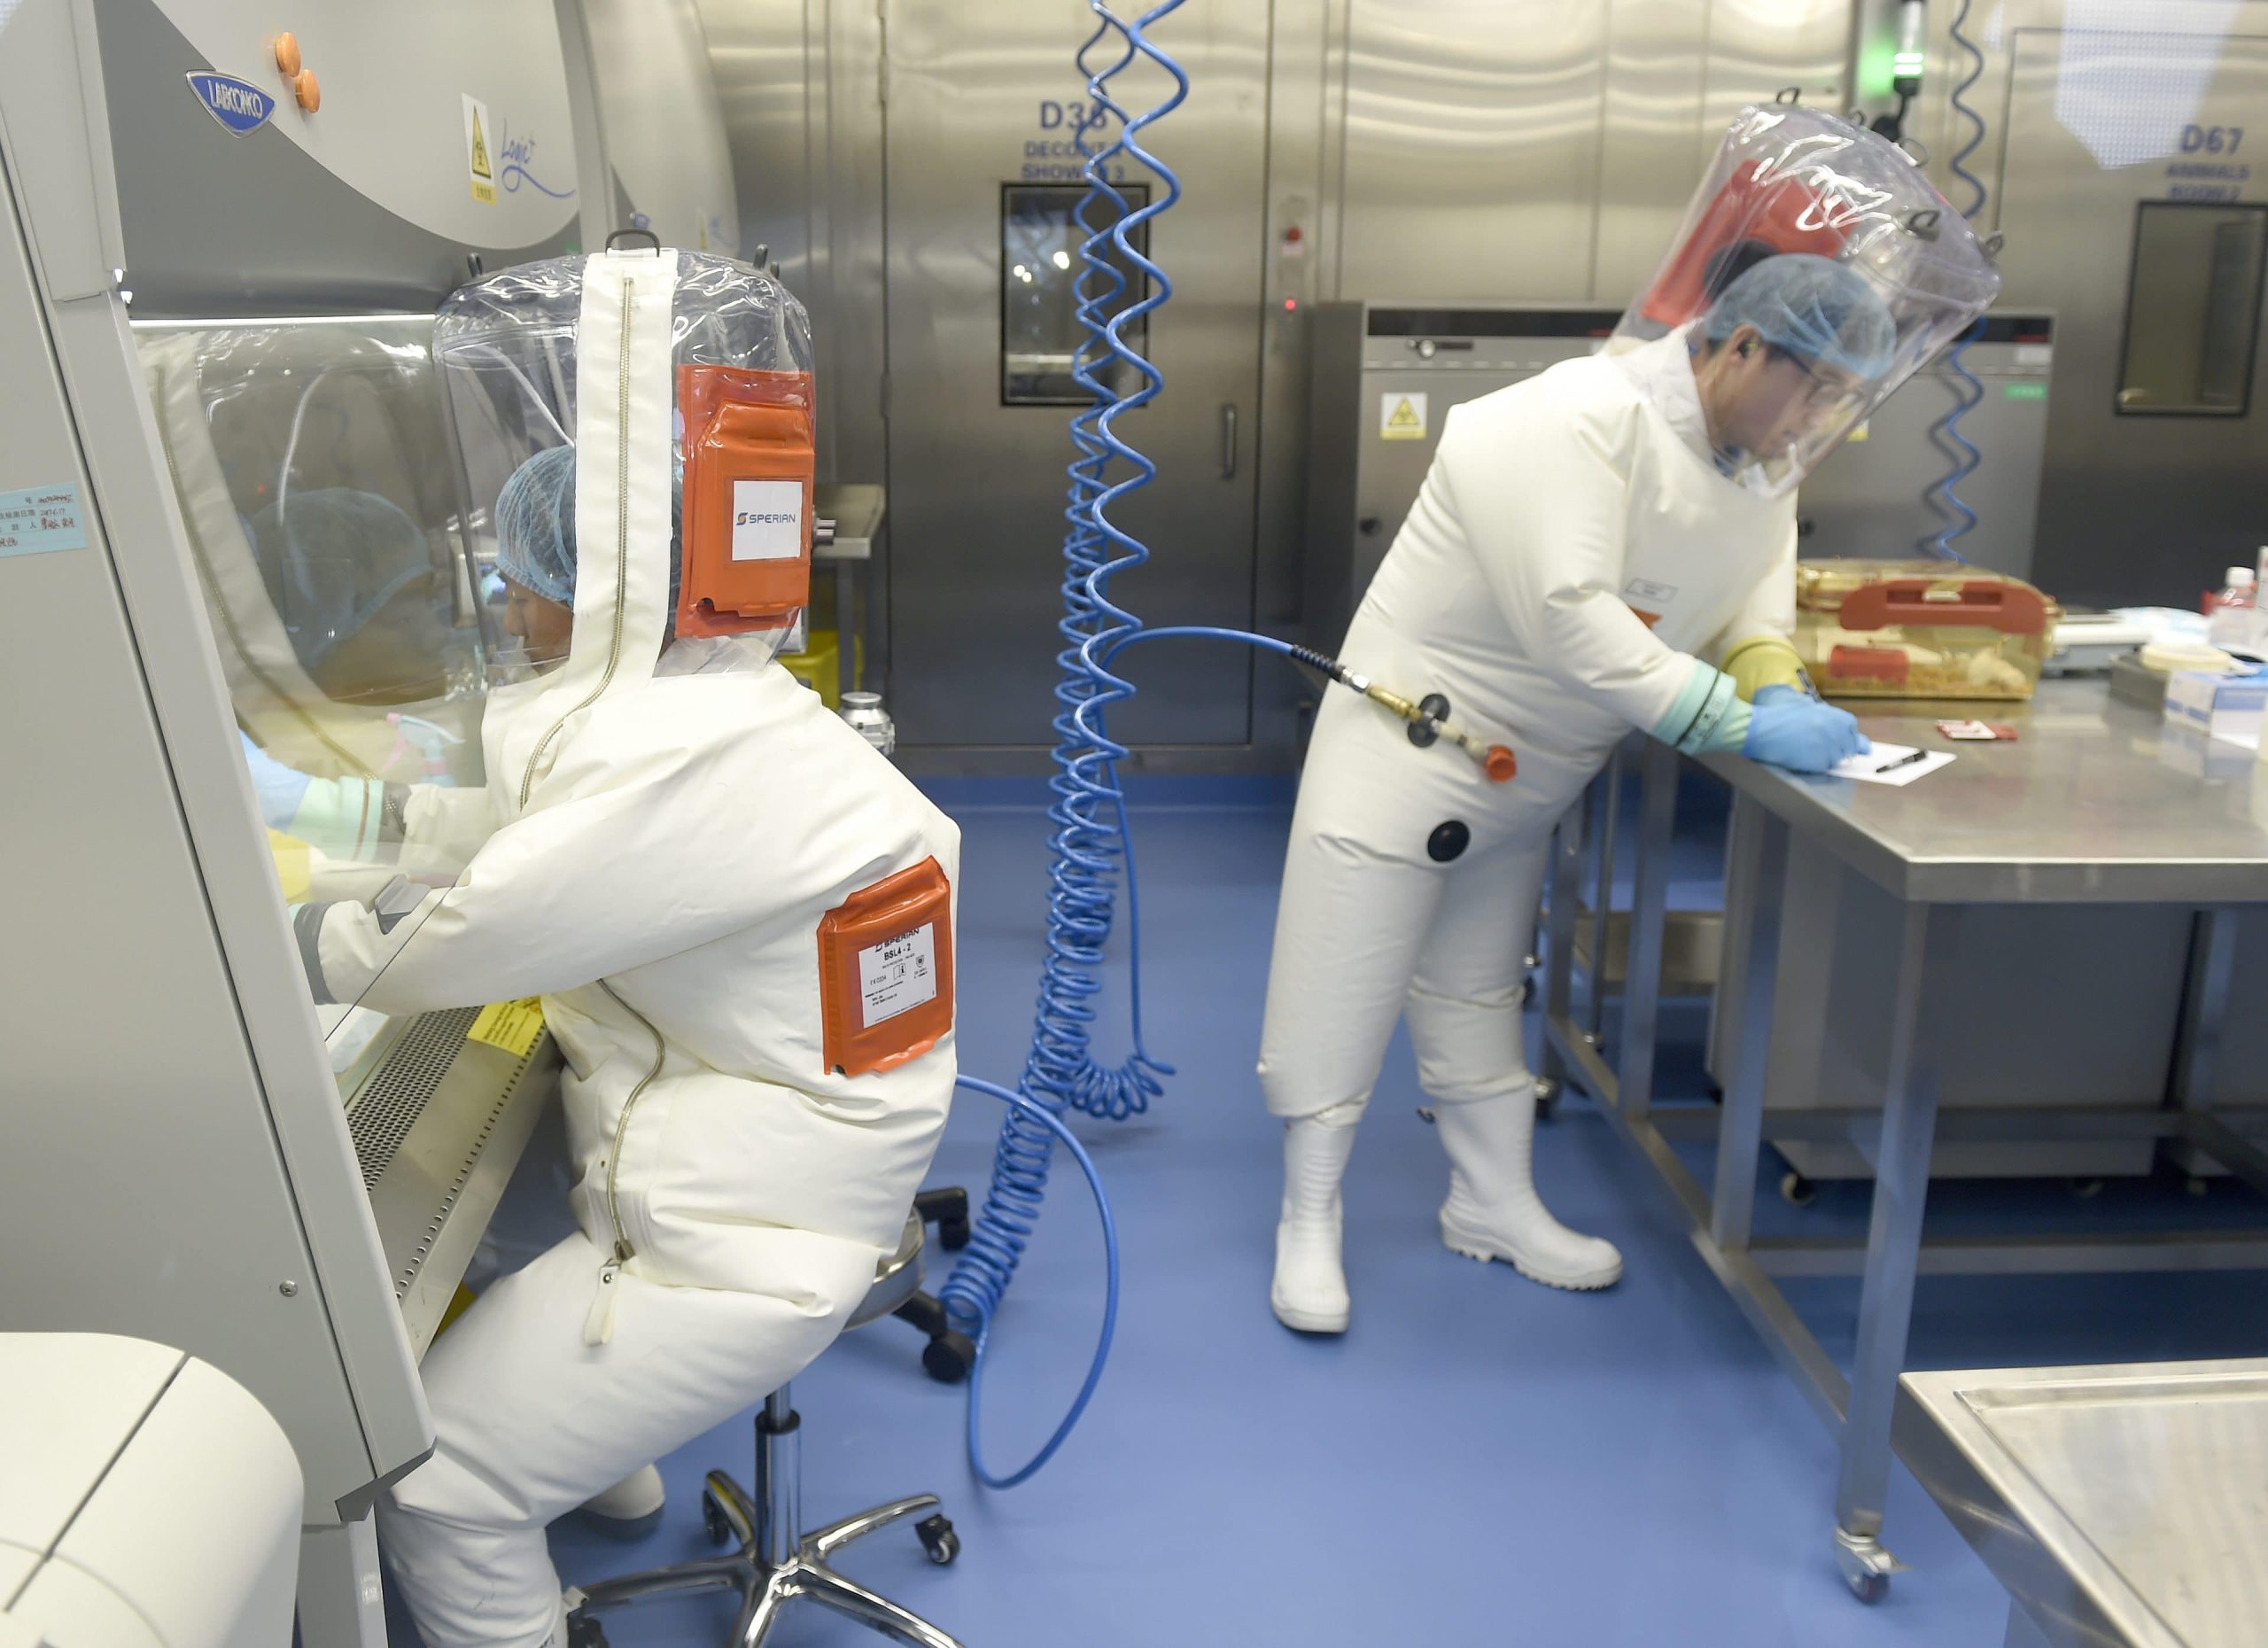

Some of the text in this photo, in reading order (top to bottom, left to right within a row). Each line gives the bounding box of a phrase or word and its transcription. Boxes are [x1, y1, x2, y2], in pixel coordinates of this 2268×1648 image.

[207, 78, 263, 119] LABCONCO
[2180, 124, 2244, 155] D67
[1021, 163, 1107, 181] SHOW
[749, 514, 796, 524] SPERIAN
[884, 946, 902, 960] BSL4
